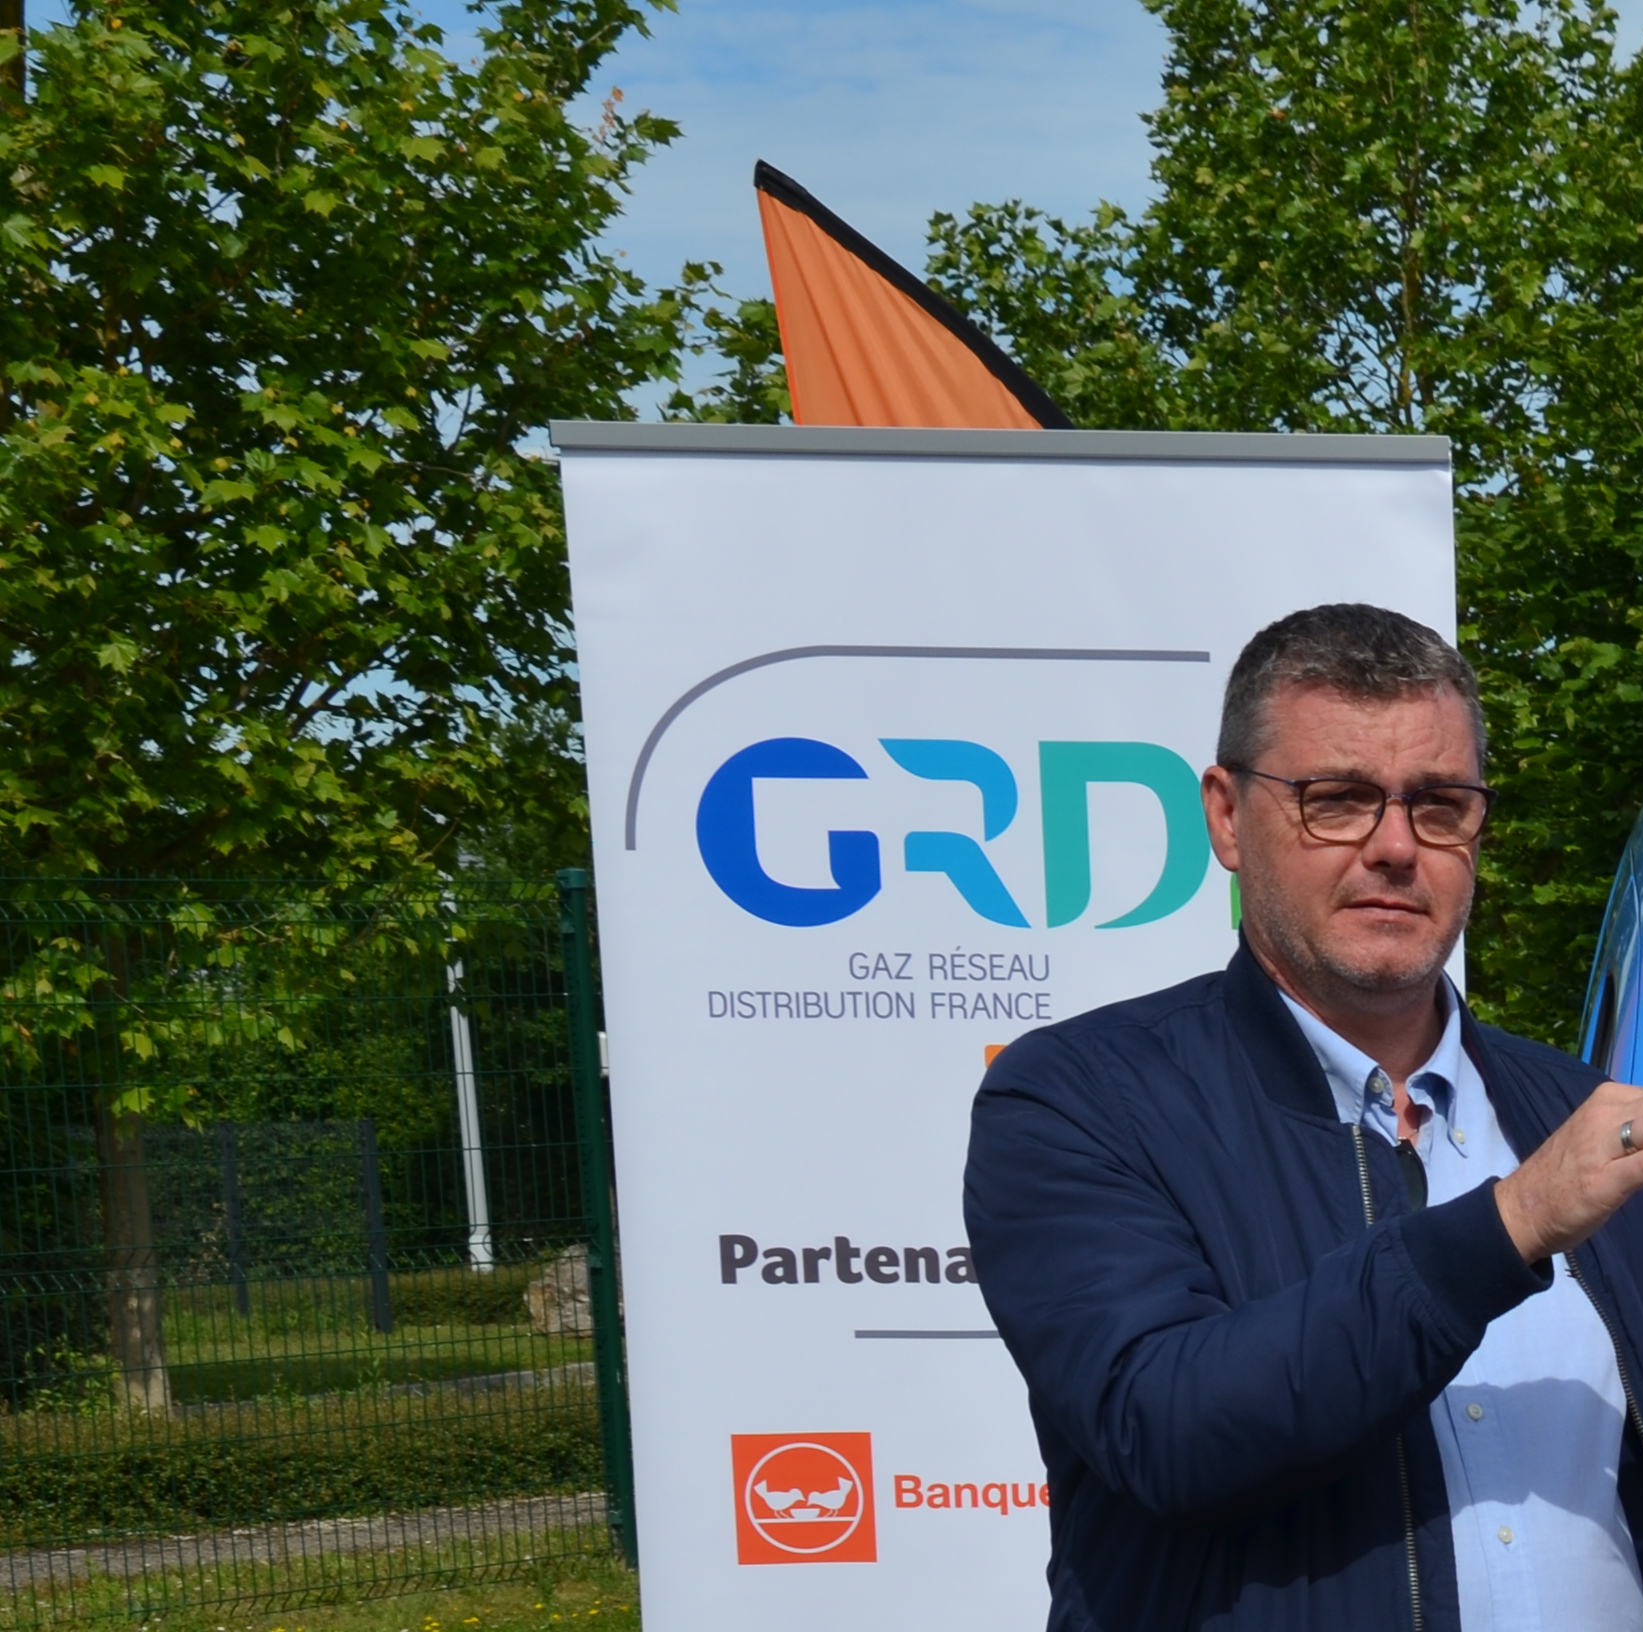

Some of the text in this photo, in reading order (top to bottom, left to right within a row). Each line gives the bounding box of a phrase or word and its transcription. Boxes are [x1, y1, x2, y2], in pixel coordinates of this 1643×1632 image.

[696, 736, 1242, 930] GRD
[848, 946, 1050, 982] GAZ RÉSEAU
[707, 990, 1053, 1020] DISTRIBUTION FRANCE
[718, 1233, 980, 1285] Partena
